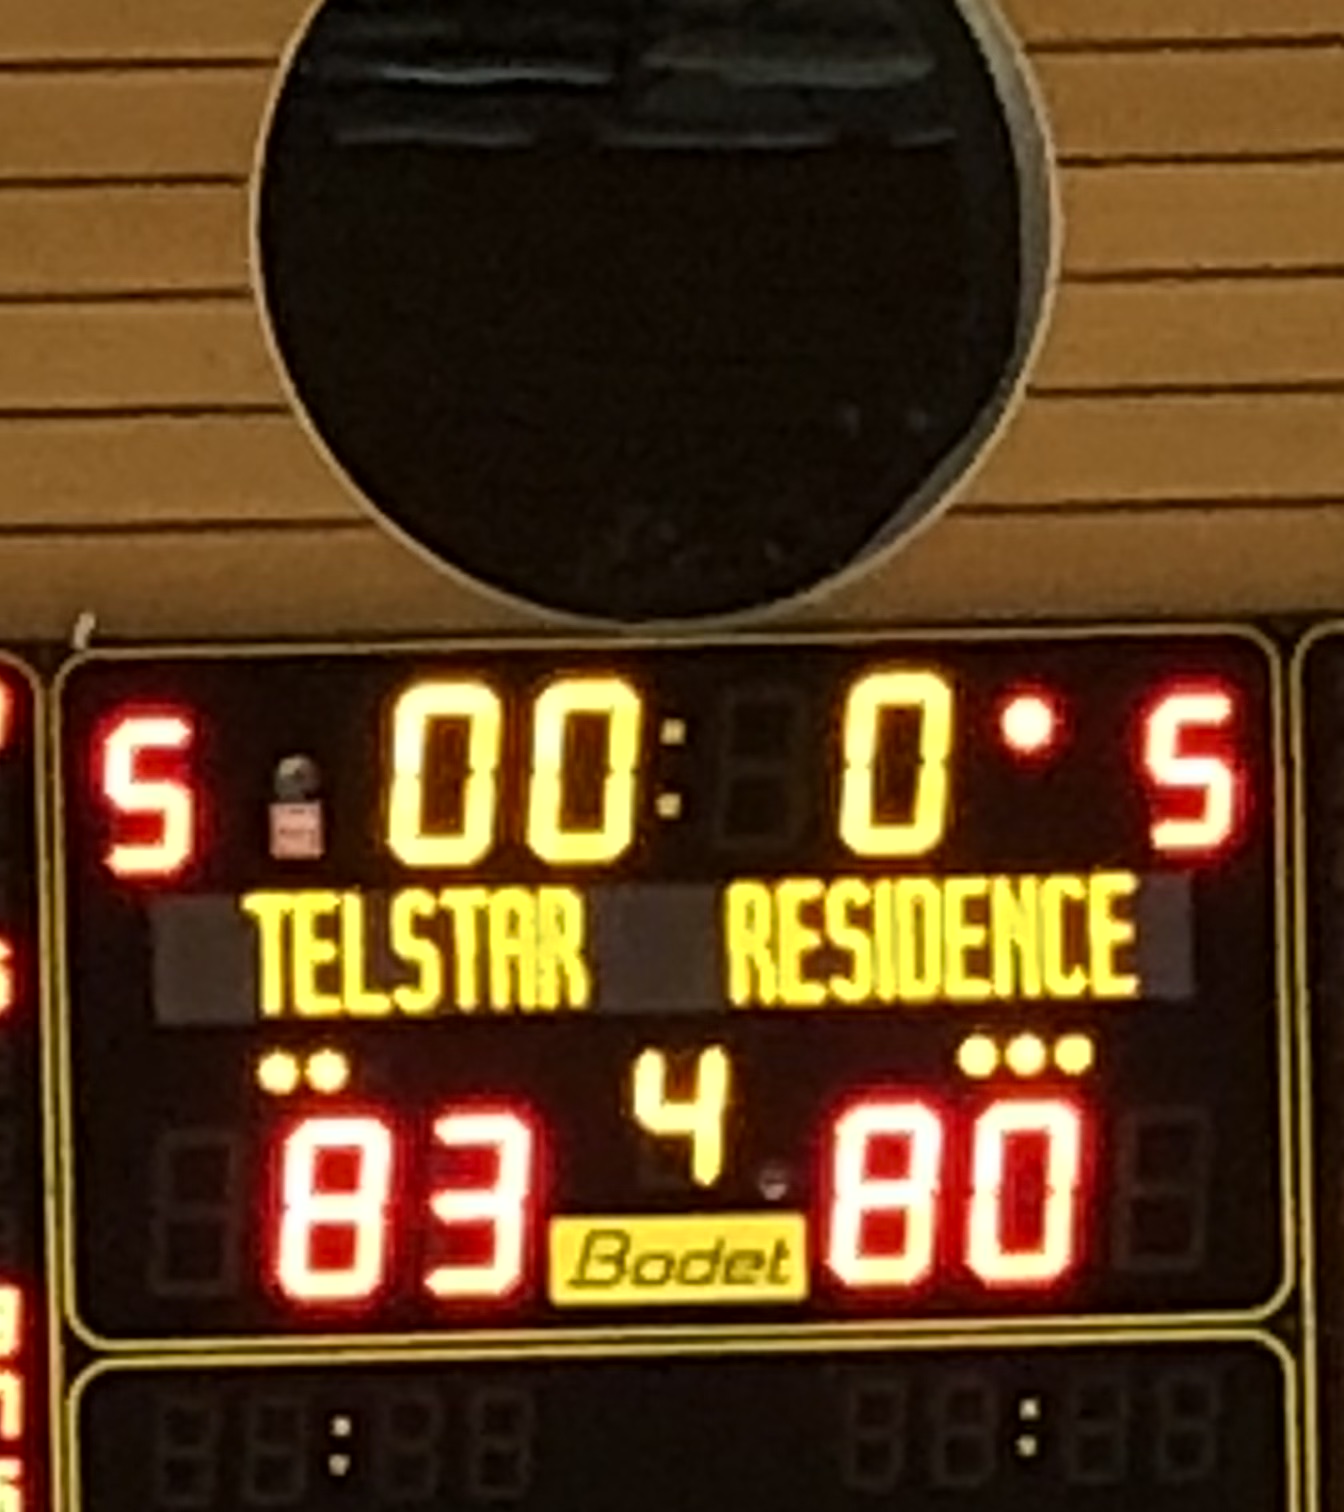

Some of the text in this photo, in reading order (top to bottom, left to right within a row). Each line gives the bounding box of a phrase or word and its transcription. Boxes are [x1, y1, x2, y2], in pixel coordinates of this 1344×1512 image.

[241, 885, 589, 1019] TELSTAR
[725, 871, 1140, 1007] RESIDENCE
[632, 1045, 730, 1186] 4
[276, 1110, 531, 1302] 83
[566, 1229, 790, 1289] Bodet
[830, 1098, 1083, 1289] 80
